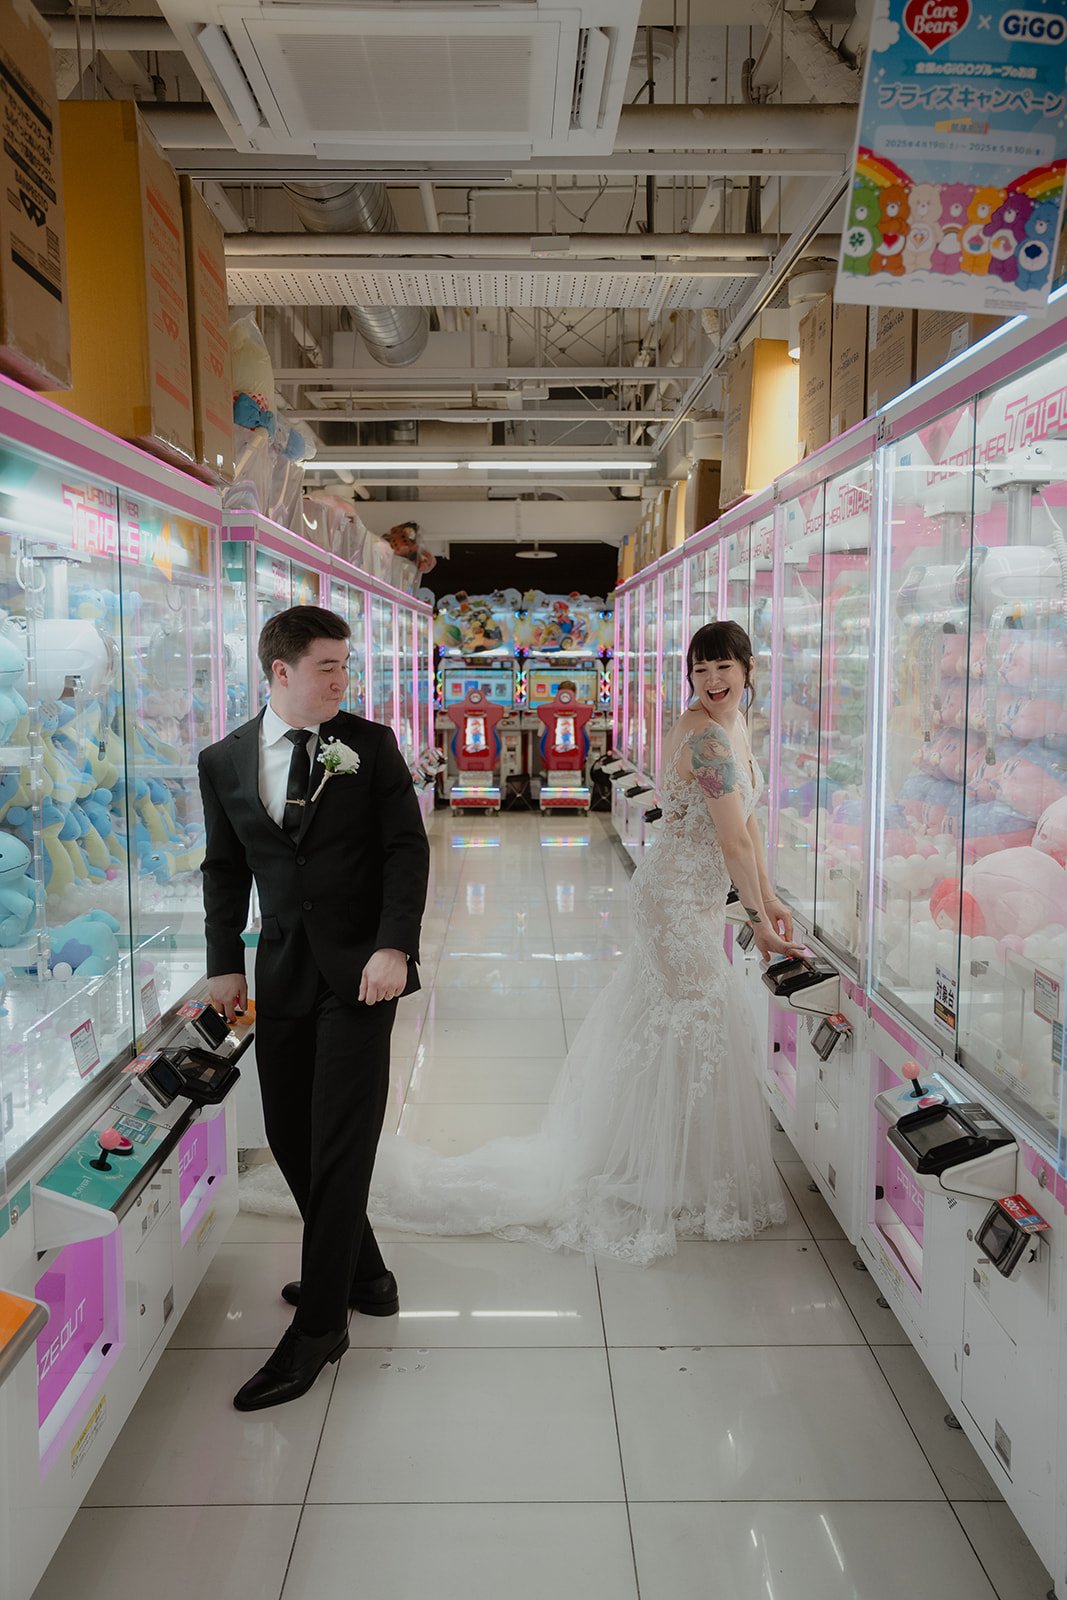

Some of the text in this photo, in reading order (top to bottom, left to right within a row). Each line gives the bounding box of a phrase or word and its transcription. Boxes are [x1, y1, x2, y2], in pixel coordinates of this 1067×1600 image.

[922, 0, 959, 19] Care
[913, 15, 959, 34] Bears
[1003, 14, 1065, 40] GiGO
[878, 84, 1066, 116] プライズキャンペーン
